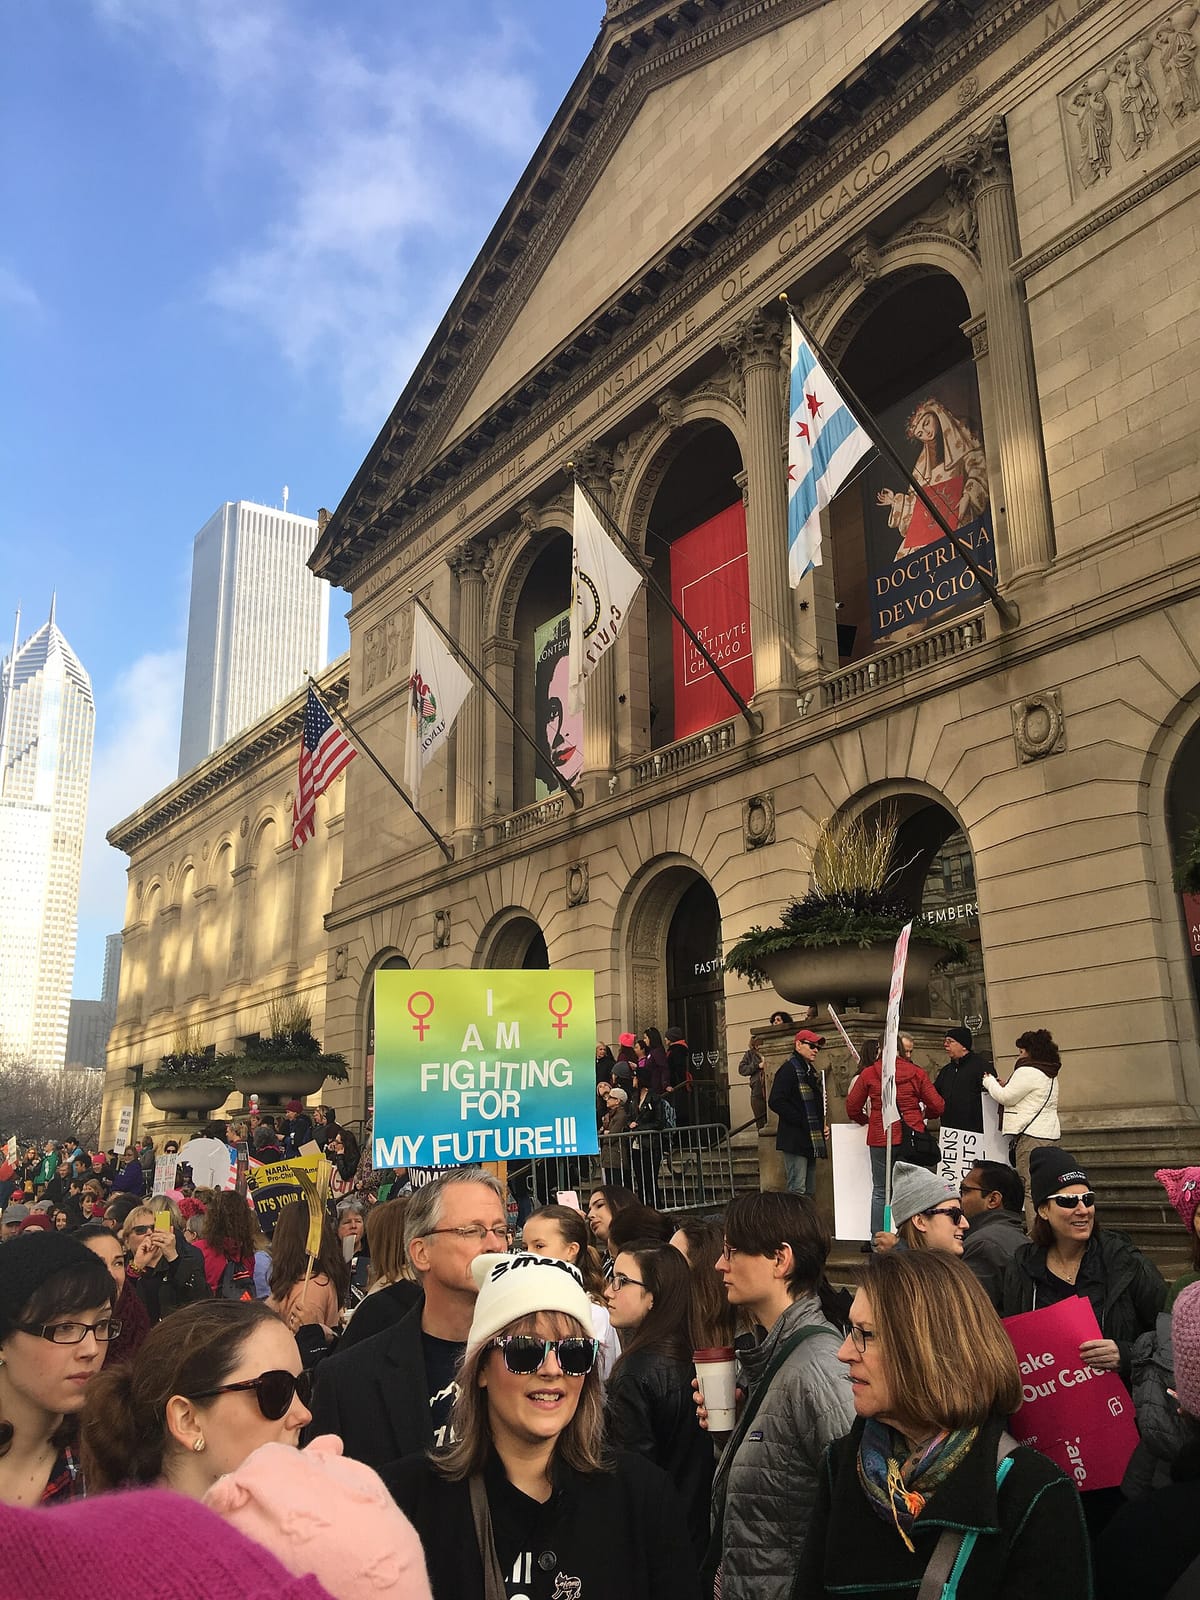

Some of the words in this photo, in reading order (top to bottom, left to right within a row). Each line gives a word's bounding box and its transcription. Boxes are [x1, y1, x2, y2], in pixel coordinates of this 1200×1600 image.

[497, 453, 527, 488] THE
[546, 411, 577, 451] ART
[596, 311, 697, 409] INSTITVTE
[721, 263, 750, 302] OF
[777, 150, 891, 255] CHICAGO
[363, 567, 392, 595] ANNO
[396, 527, 438, 571] DOMINI
[875, 526, 990, 596] DOCTRINA
[928, 571, 937, 584] Y
[878, 559, 994, 629] DEVOCIÓN
[916, 902, 979, 926] EMBERS
[694, 959, 717, 975] FAST
[487, 989, 493, 1017] I
[420, 1058, 573, 1092] FIGHTING
[460, 1090, 521, 1120] FOR
[375, 1135, 425, 1167] MY
[432, 1116, 578, 1164] FUTURE!!!
[942, 1130, 959, 1181] OMEN'S
[265, 1164, 291, 1176] NARAL
[267, 1173, 295, 1183] Pro-Choi
[409, 1168, 448, 1188] WOM
[257, 1197, 276, 1213] IT'S
[276, 1192, 299, 1208] YOUR
[1019, 1352, 1055, 1375] ake
[1022, 1378, 1057, 1402] Our
[1065, 1437, 1087, 1487] are.
